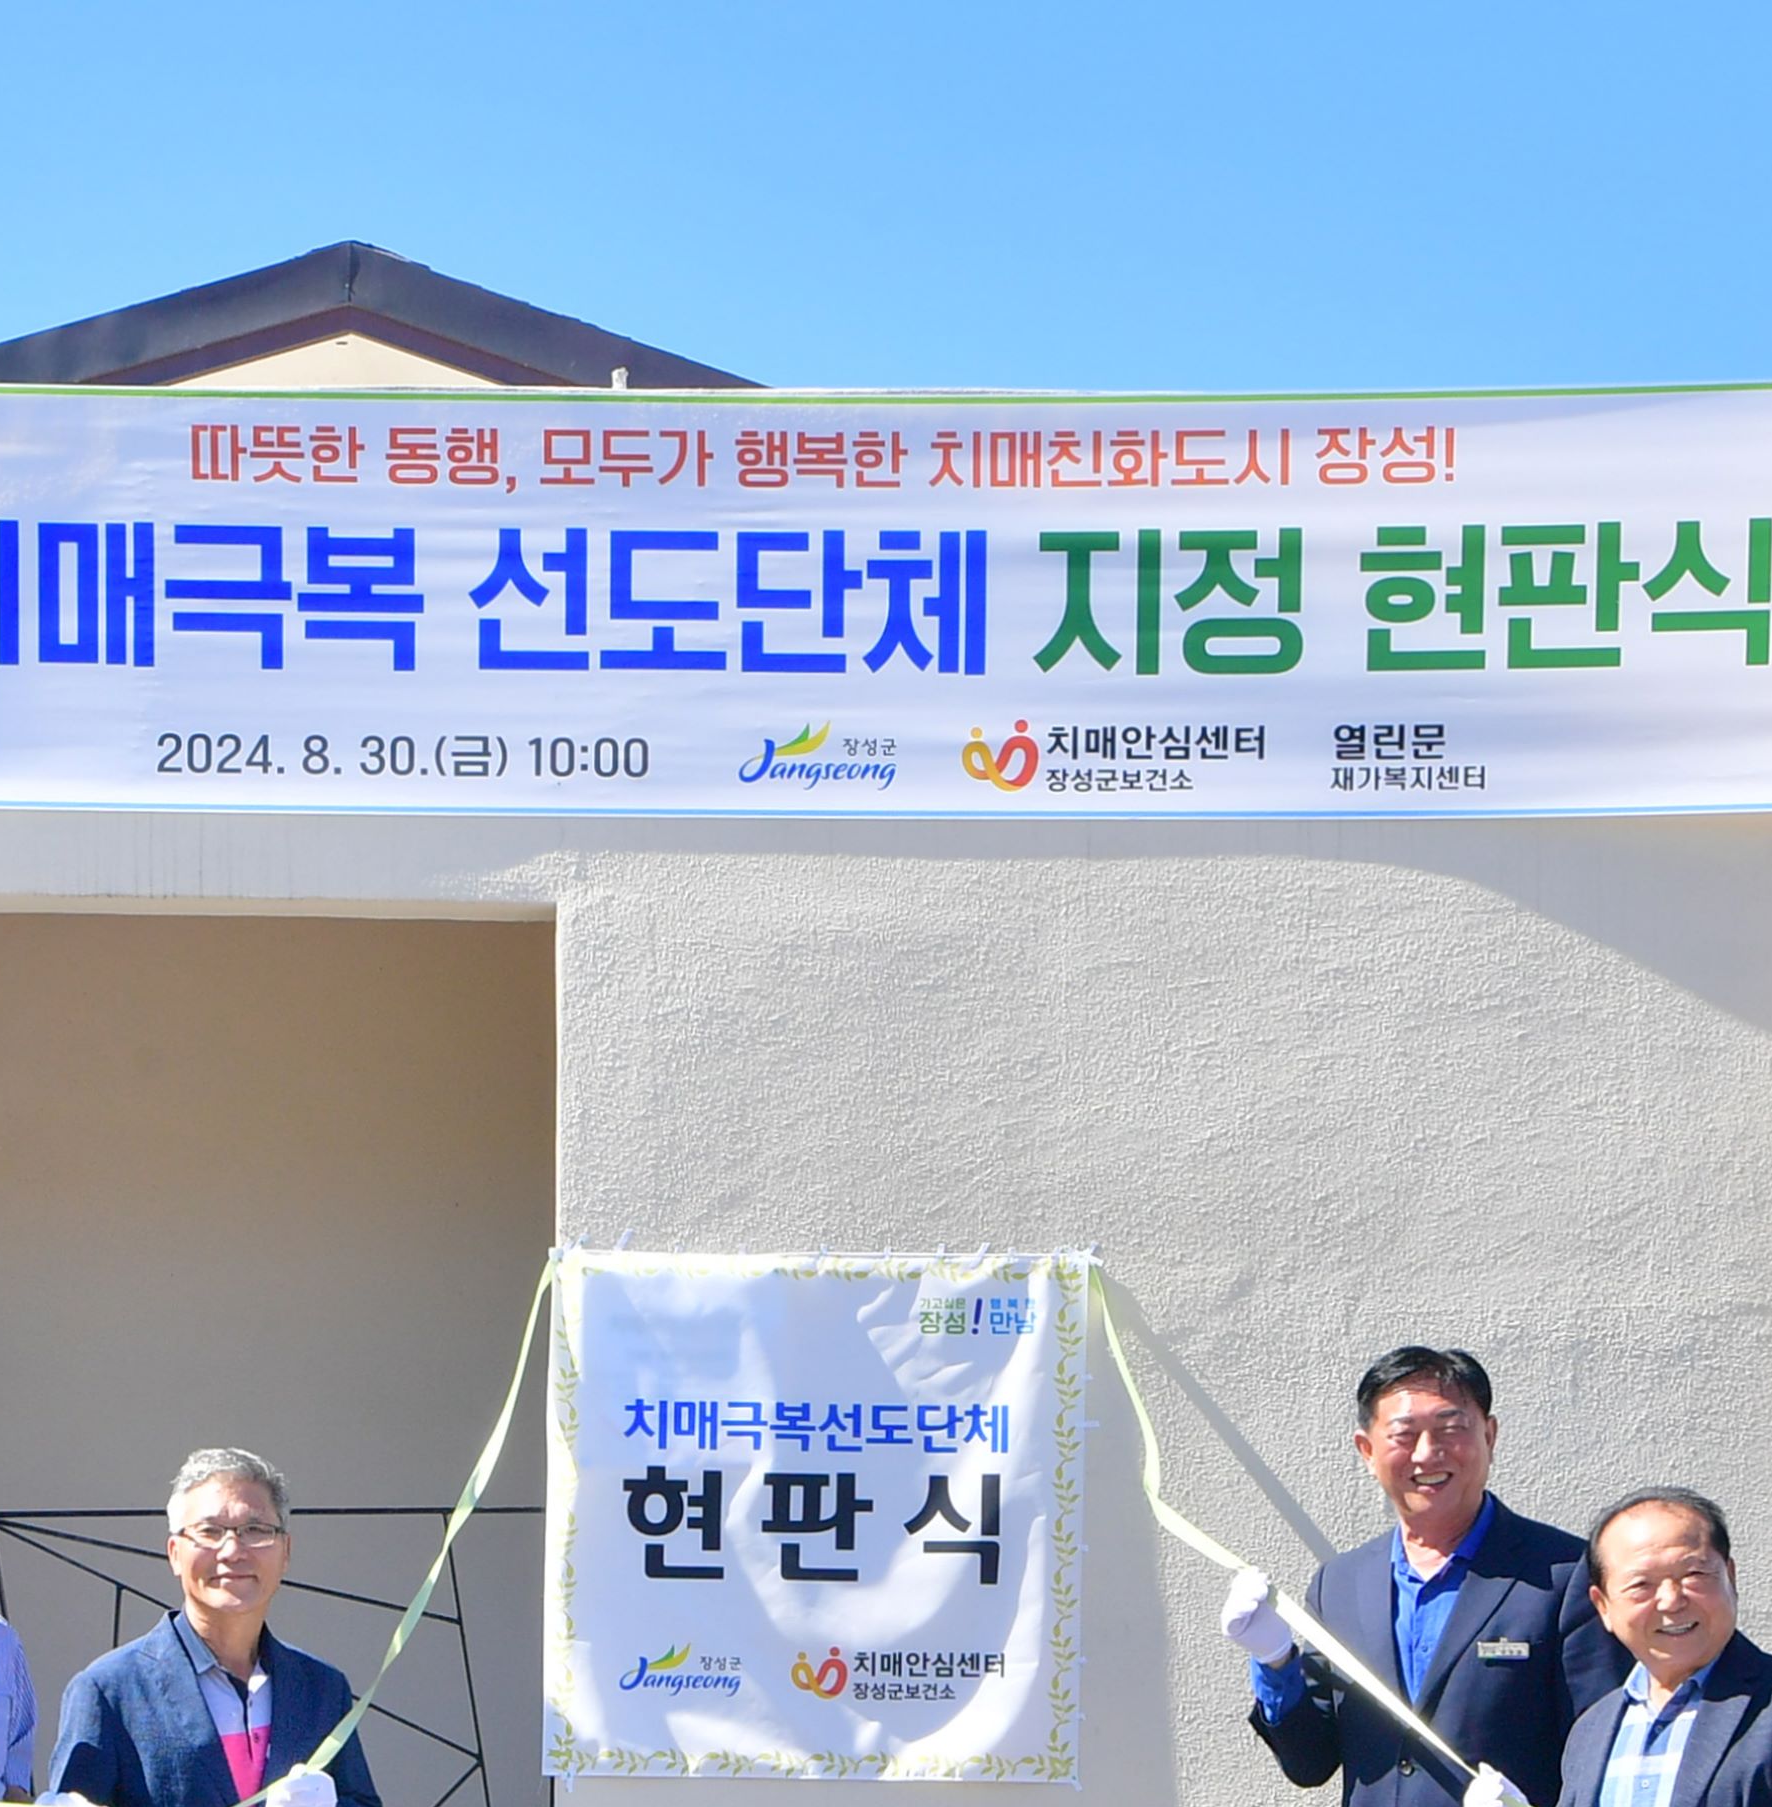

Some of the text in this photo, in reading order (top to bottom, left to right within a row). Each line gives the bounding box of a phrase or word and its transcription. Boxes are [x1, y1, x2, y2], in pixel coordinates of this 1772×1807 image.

[190, 425, 1456, 494] 따뜻한 동행, 모두가 행복한 치매친화도시 장성!
[468, 527, 987, 676] 선도단체
[1033, 527, 1304, 676] 지정
[1359, 517, 1772, 672] 현판식
[156, 732, 285, 775] 2024.
[301, 733, 342, 776] 8.
[528, 736, 649, 778] 10:00
[841, 737, 898, 758] 장성군
[1046, 724, 1267, 761] 치매안심센터
[1333, 723, 1446, 761] 열린문
[738, 738, 898, 790] Jangseong
[1045, 767, 1195, 793] 장성군보건소
[1330, 764, 1486, 792] 재가복지센터
[623, 1398, 1009, 1454] 치매극복선도단체
[619, 1656, 741, 1697] Jangseong
[700, 1656, 742, 1671] 장성군
[853, 1651, 1005, 1678] 치매안심센터
[852, 1682, 956, 1700] 장성군보건소
